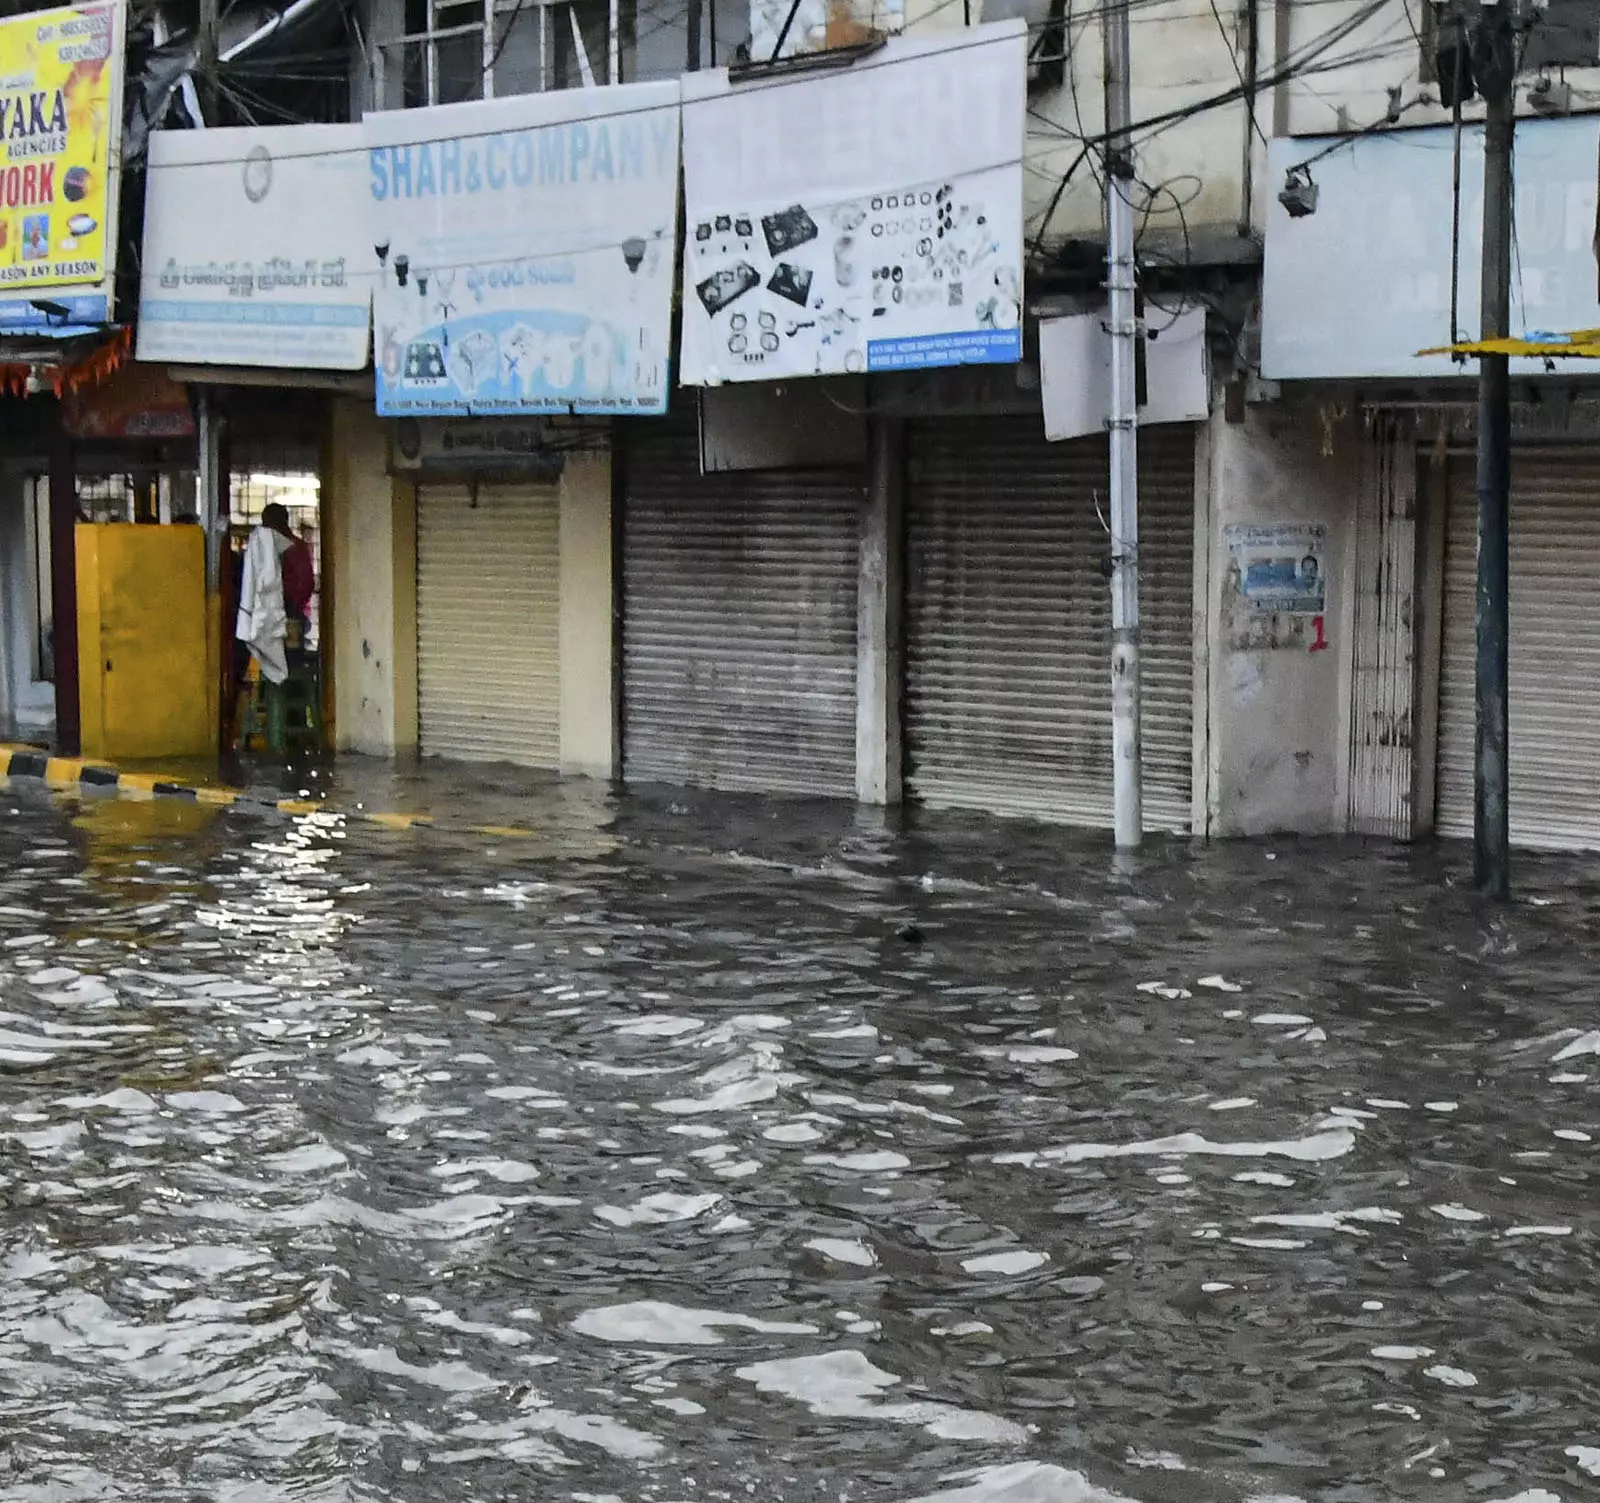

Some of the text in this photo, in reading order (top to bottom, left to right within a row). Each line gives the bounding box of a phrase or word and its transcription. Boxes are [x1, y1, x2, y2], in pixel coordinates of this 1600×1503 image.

[7, 135, 67, 159] AGENCIES
[31, 263, 50, 277] ANY
[55, 261, 97, 276] SEASON
